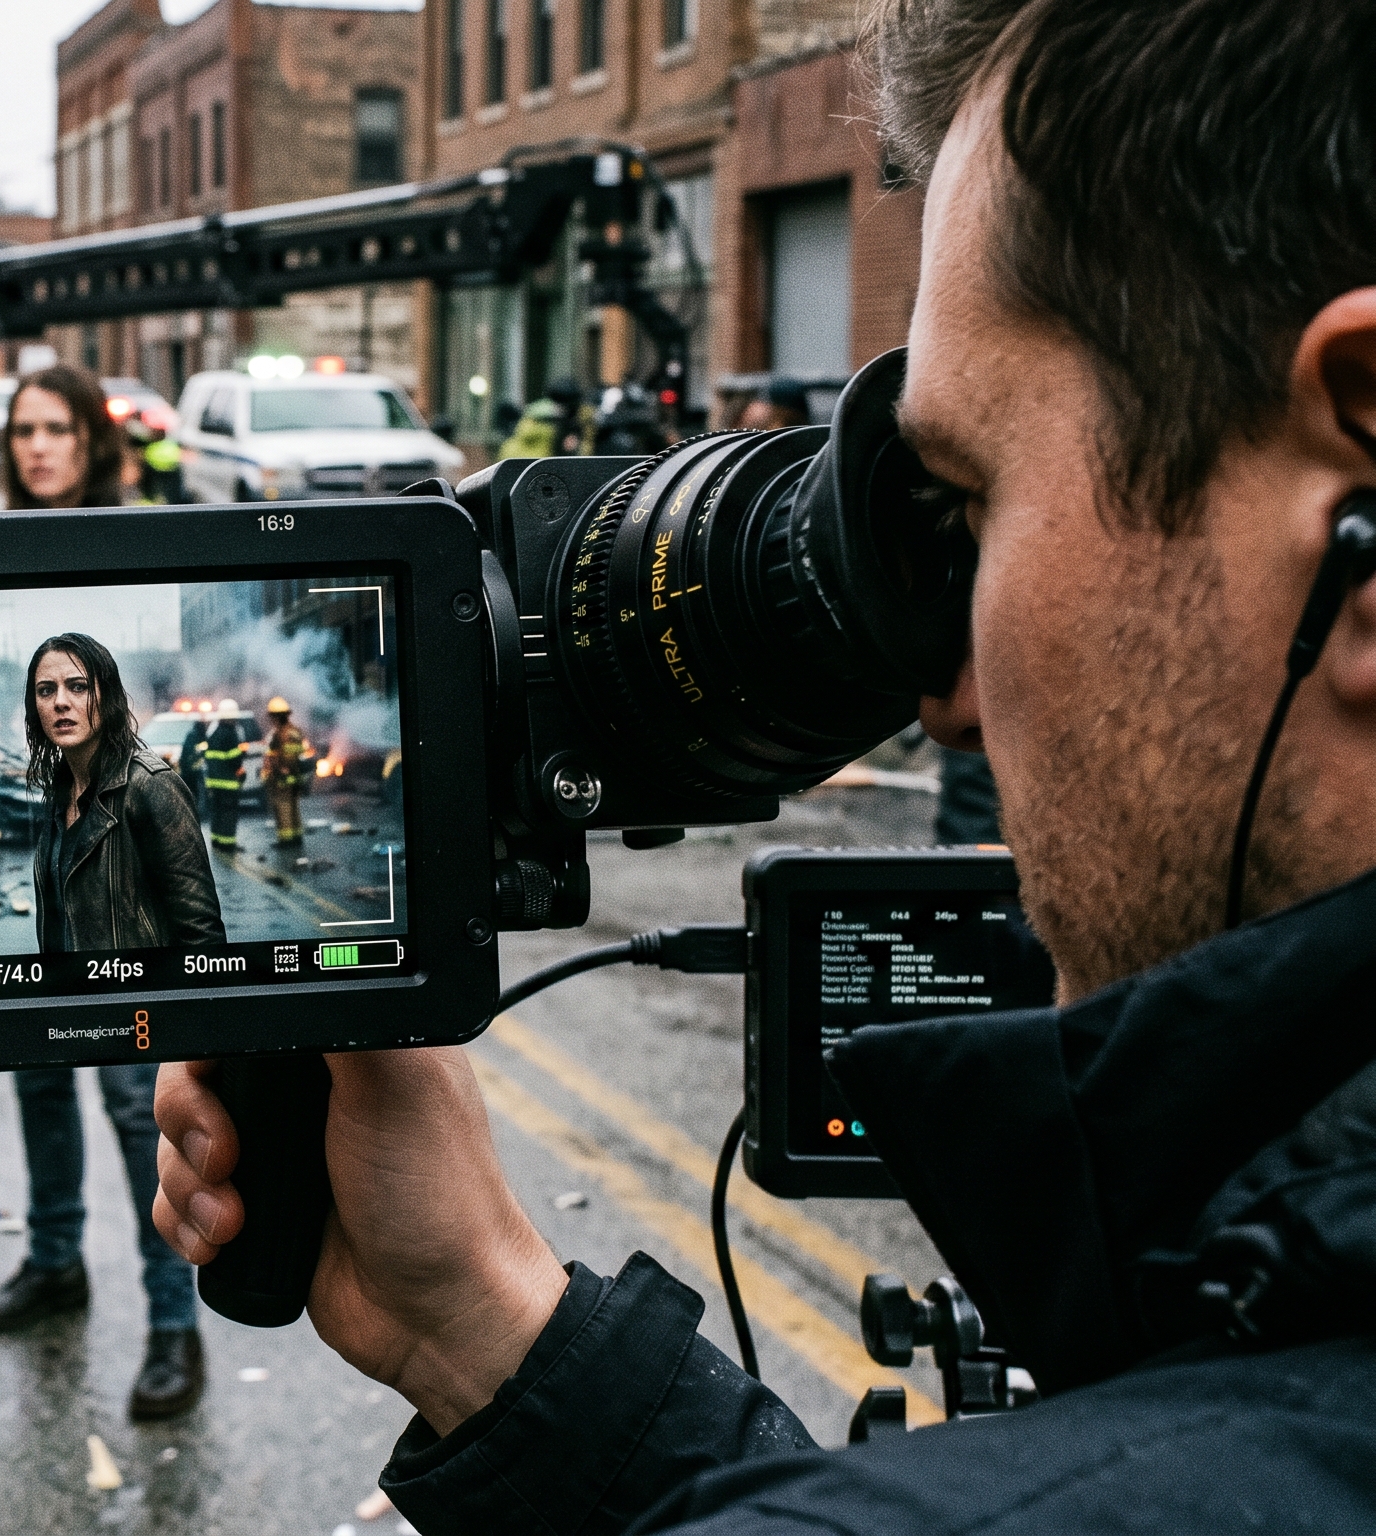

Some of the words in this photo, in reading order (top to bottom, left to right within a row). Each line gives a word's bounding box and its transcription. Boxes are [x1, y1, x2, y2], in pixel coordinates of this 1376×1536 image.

[258, 515, 294, 531] 16:9
[652, 529, 673, 611] PRIME
[660, 627, 703, 703] ULTRA
[87, 958, 143, 982] 24fps
[185, 955, 245, 973] 50mm
